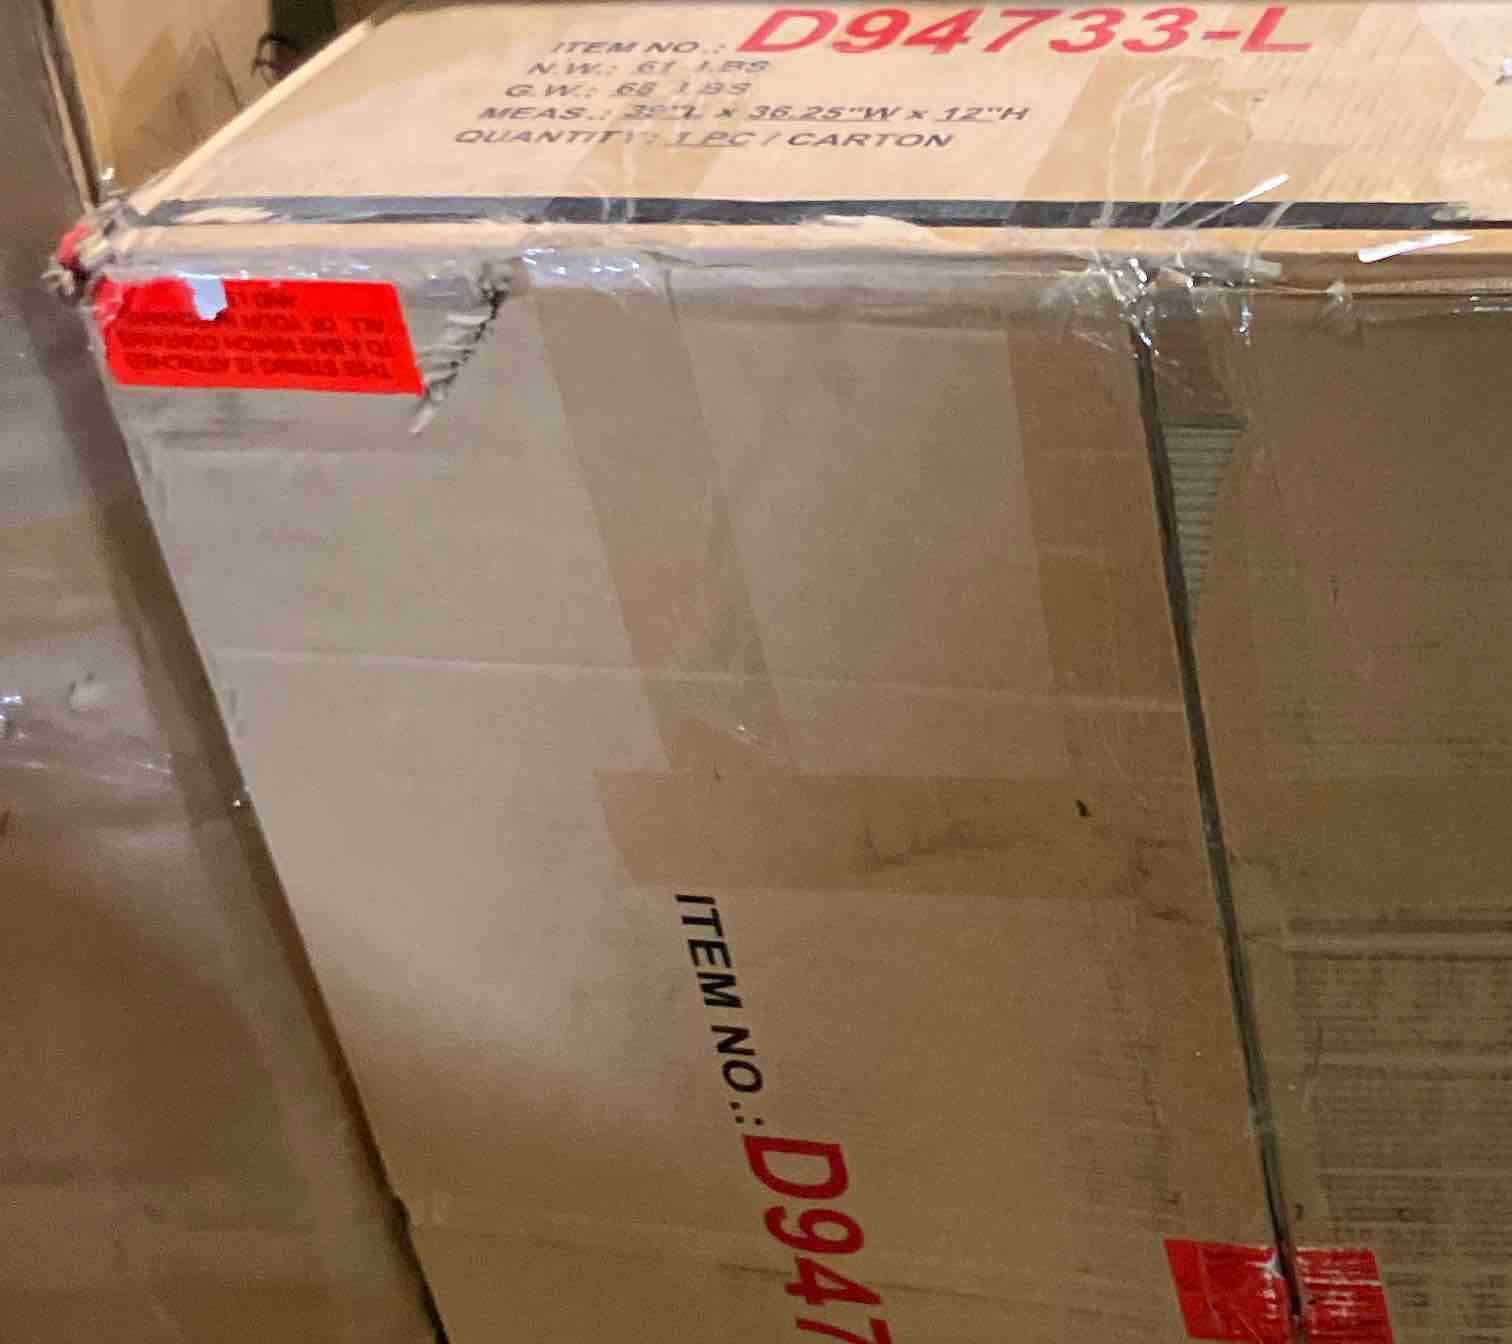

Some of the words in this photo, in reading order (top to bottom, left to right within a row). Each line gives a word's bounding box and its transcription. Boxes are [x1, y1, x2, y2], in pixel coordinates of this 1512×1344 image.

[551, 41, 638, 55] ITEM
[737, 6, 1314, 55] D94733-L
[746, 105, 901, 123] 36.25"W
[905, 109, 930, 121] x
[934, 107, 1031, 123] 12"H
[786, 132, 955, 148] CARTON
[674, 893, 744, 1009] ITEM
[709, 1023, 766, 1126] NO.:
